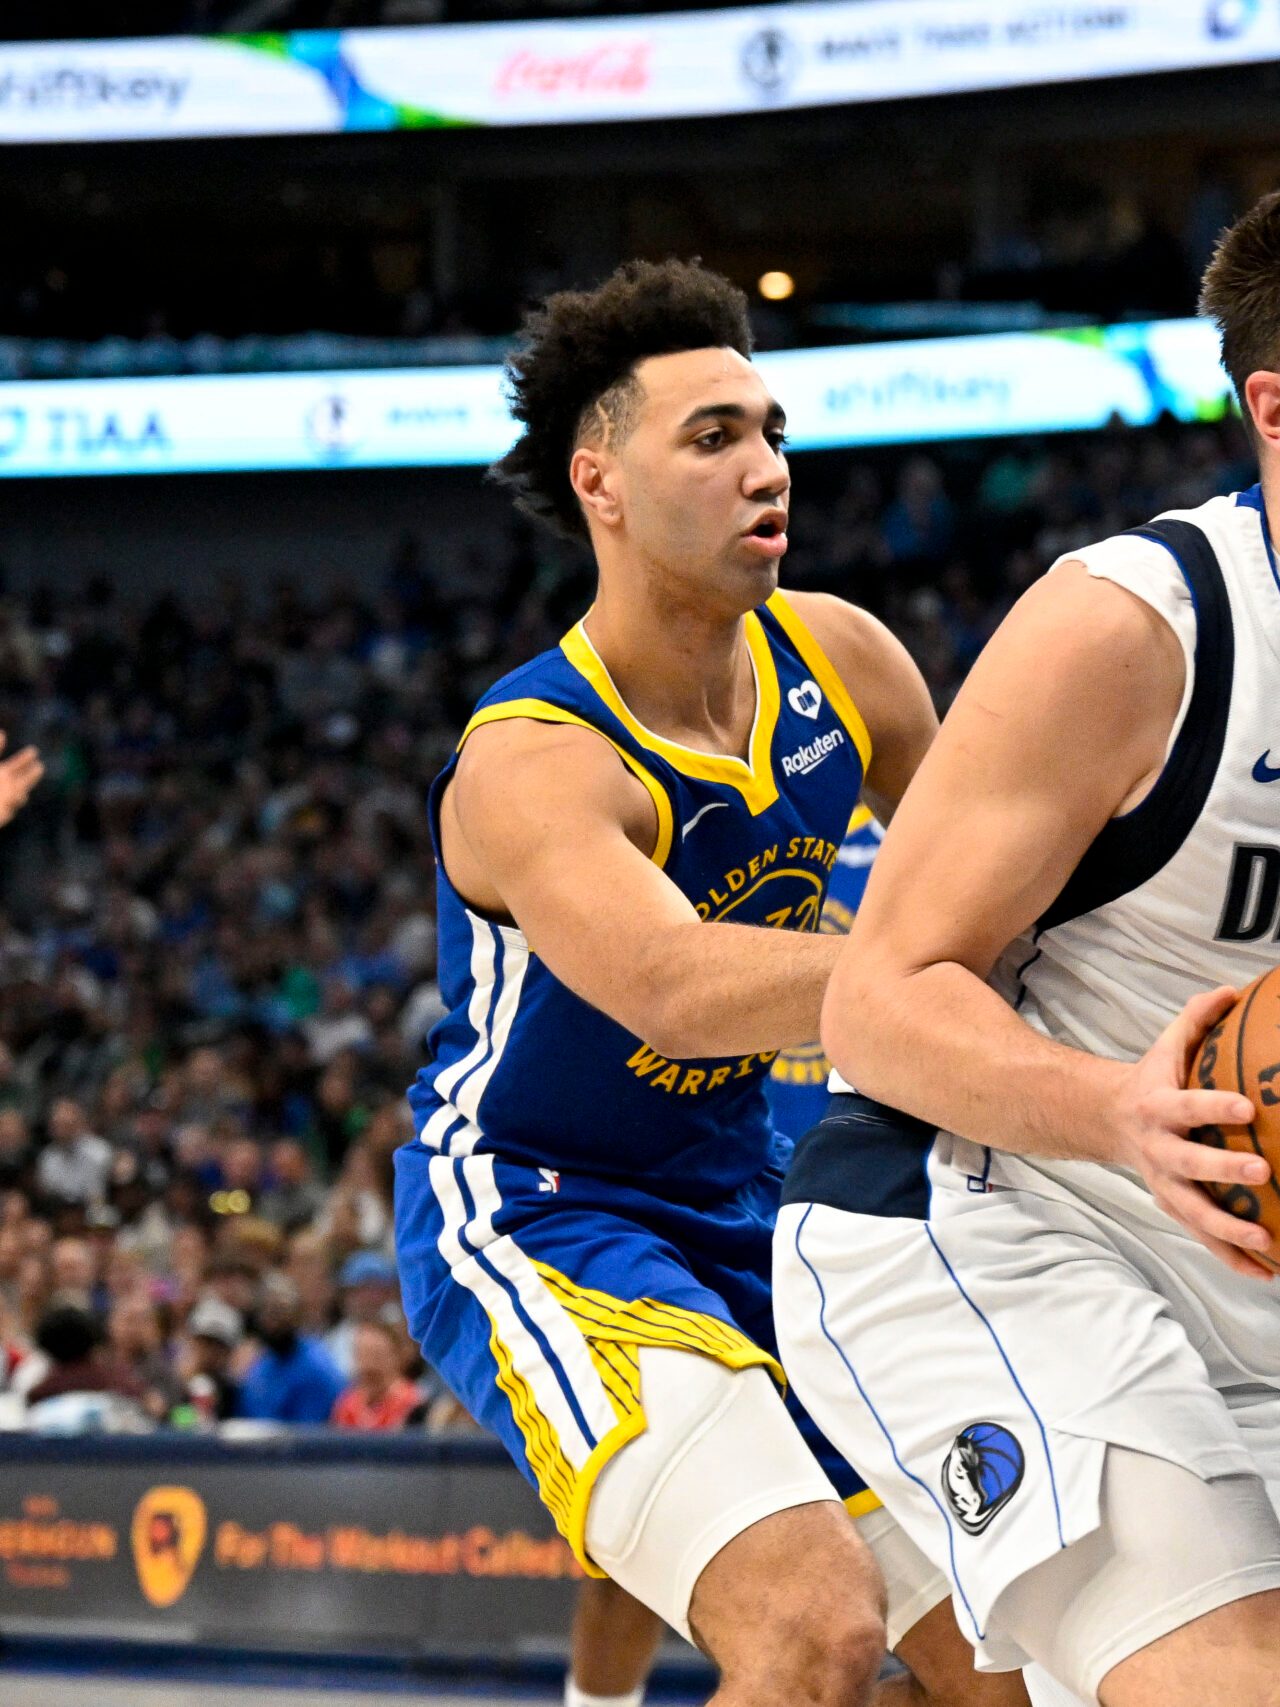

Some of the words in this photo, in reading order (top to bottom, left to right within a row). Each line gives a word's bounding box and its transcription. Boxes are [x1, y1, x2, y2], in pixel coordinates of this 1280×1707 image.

[781, 728, 845, 777] Rakuten
[694, 844, 778, 923] OLDEN
[786, 836, 839, 872] STATE
